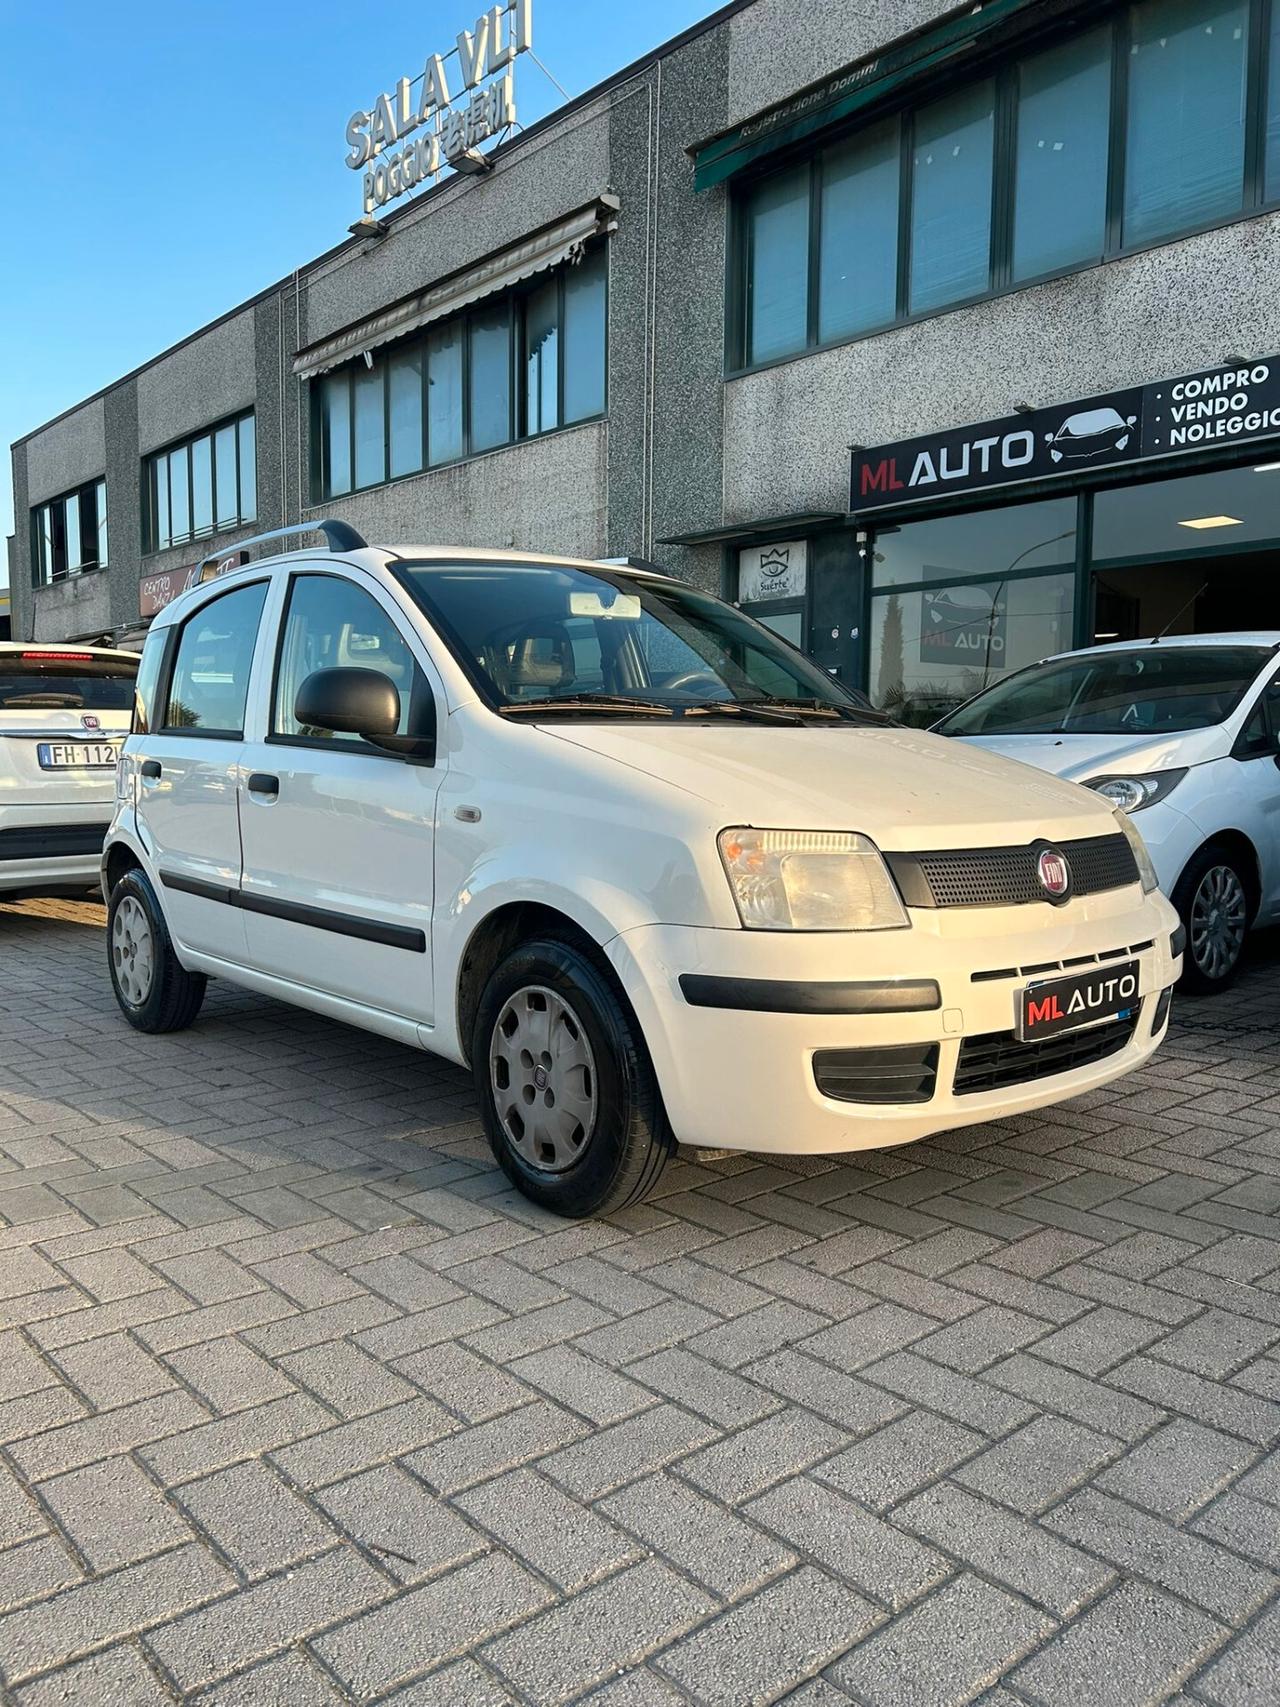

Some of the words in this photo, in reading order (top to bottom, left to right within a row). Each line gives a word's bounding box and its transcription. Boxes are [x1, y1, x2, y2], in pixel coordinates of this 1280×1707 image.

[345, 54, 450, 170] SALA
[364, 132, 439, 214] POGGIO
[1172, 365, 1269, 400] COMPRO
[1171, 392, 1248, 423] VENDO
[1170, 408, 1280, 446] NOLEGGIO
[861, 458, 905, 496] ML
[908, 430, 1034, 487] AUTO
[144, 576, 170, 595] CENTRO
[954, 632, 1004, 652] AUTO
[52, 746, 76, 763] FH
[1044, 862, 1063, 884] FIAT
[1028, 995, 1064, 1026] ML
[1066, 974, 1136, 1015] AUTO
